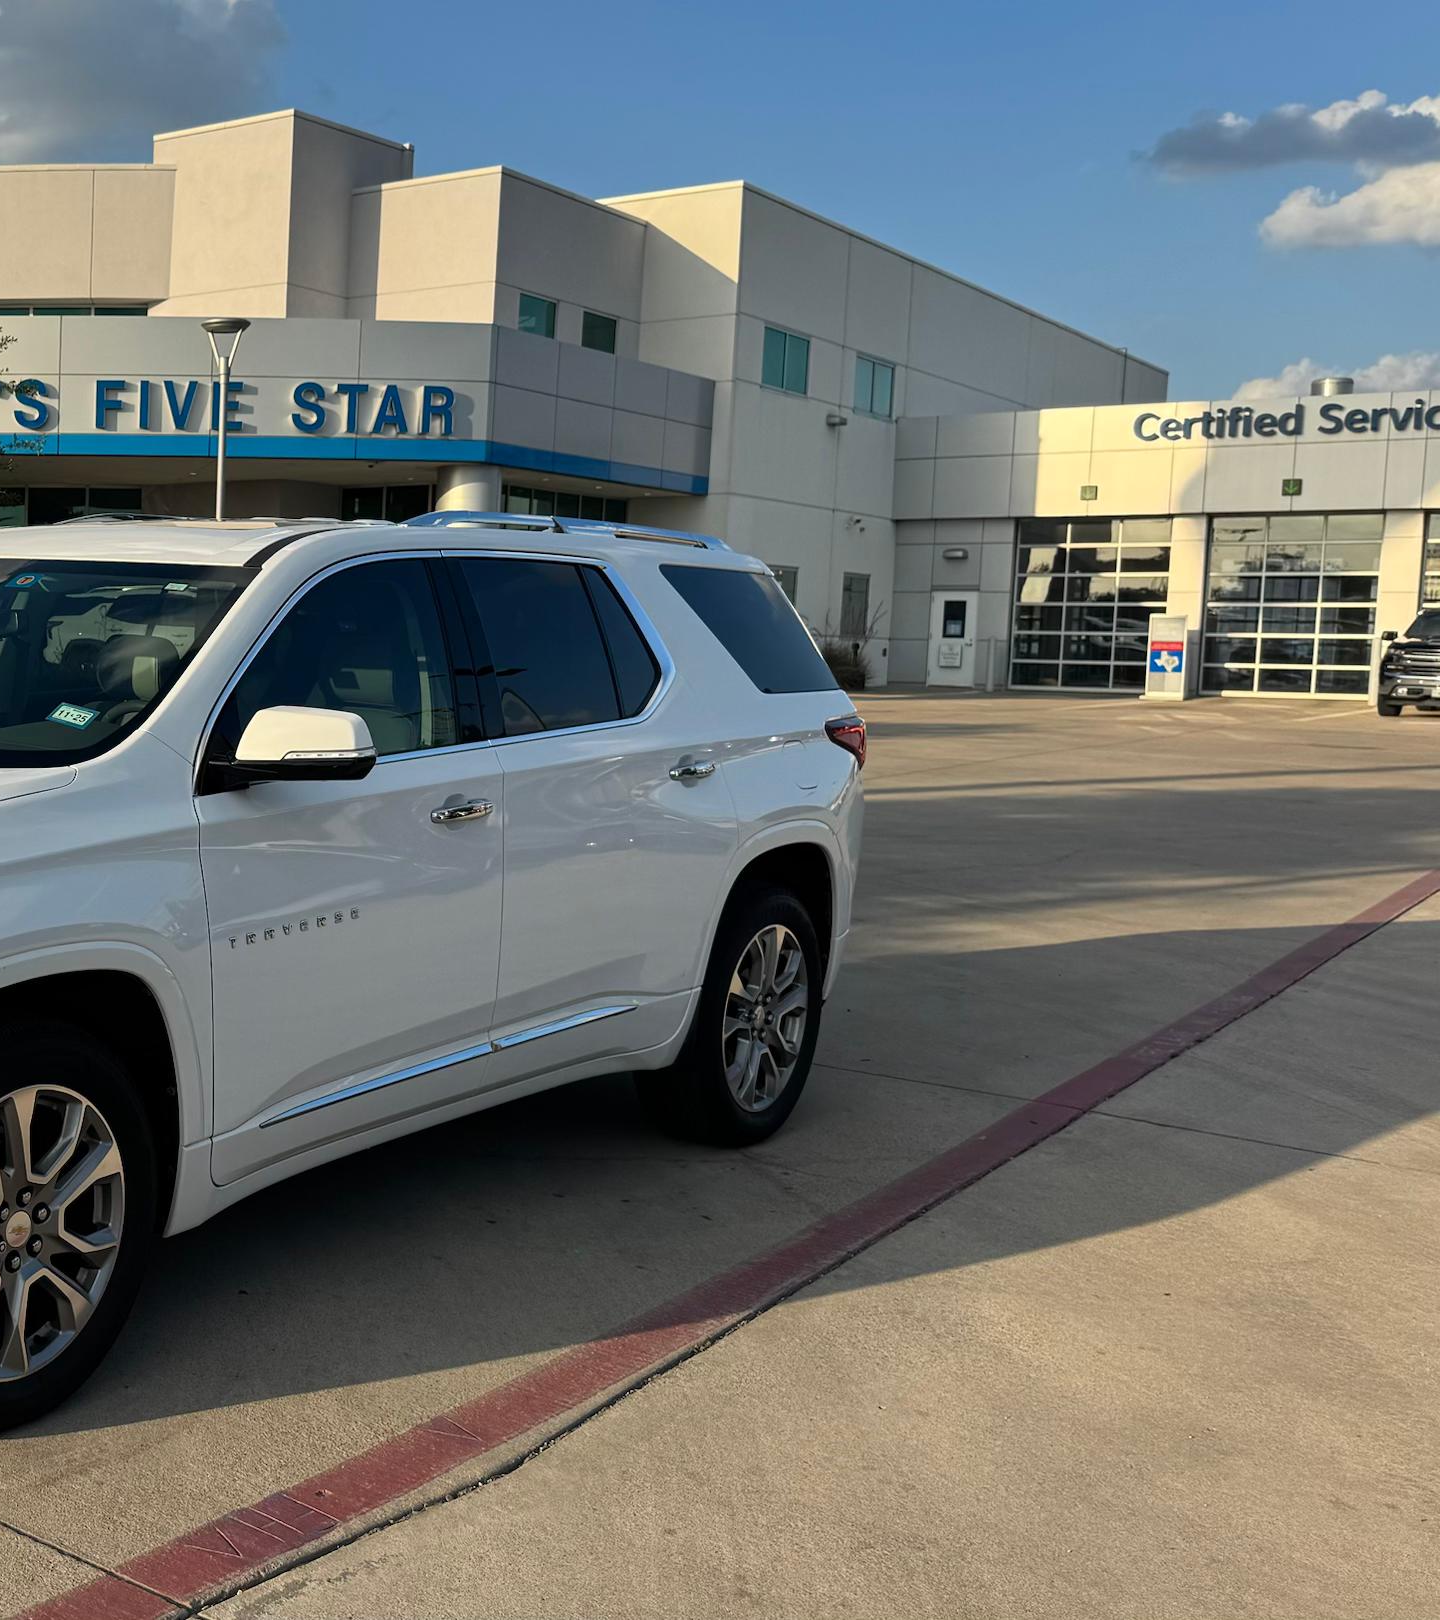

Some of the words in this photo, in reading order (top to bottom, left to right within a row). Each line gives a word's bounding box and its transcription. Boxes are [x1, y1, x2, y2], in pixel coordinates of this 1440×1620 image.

[95, 380, 244, 432] FIVE
[291, 382, 455, 435] STAR
[1133, 404, 1304, 442] Certified
[228, 907, 360, 949] TRAVERSE
